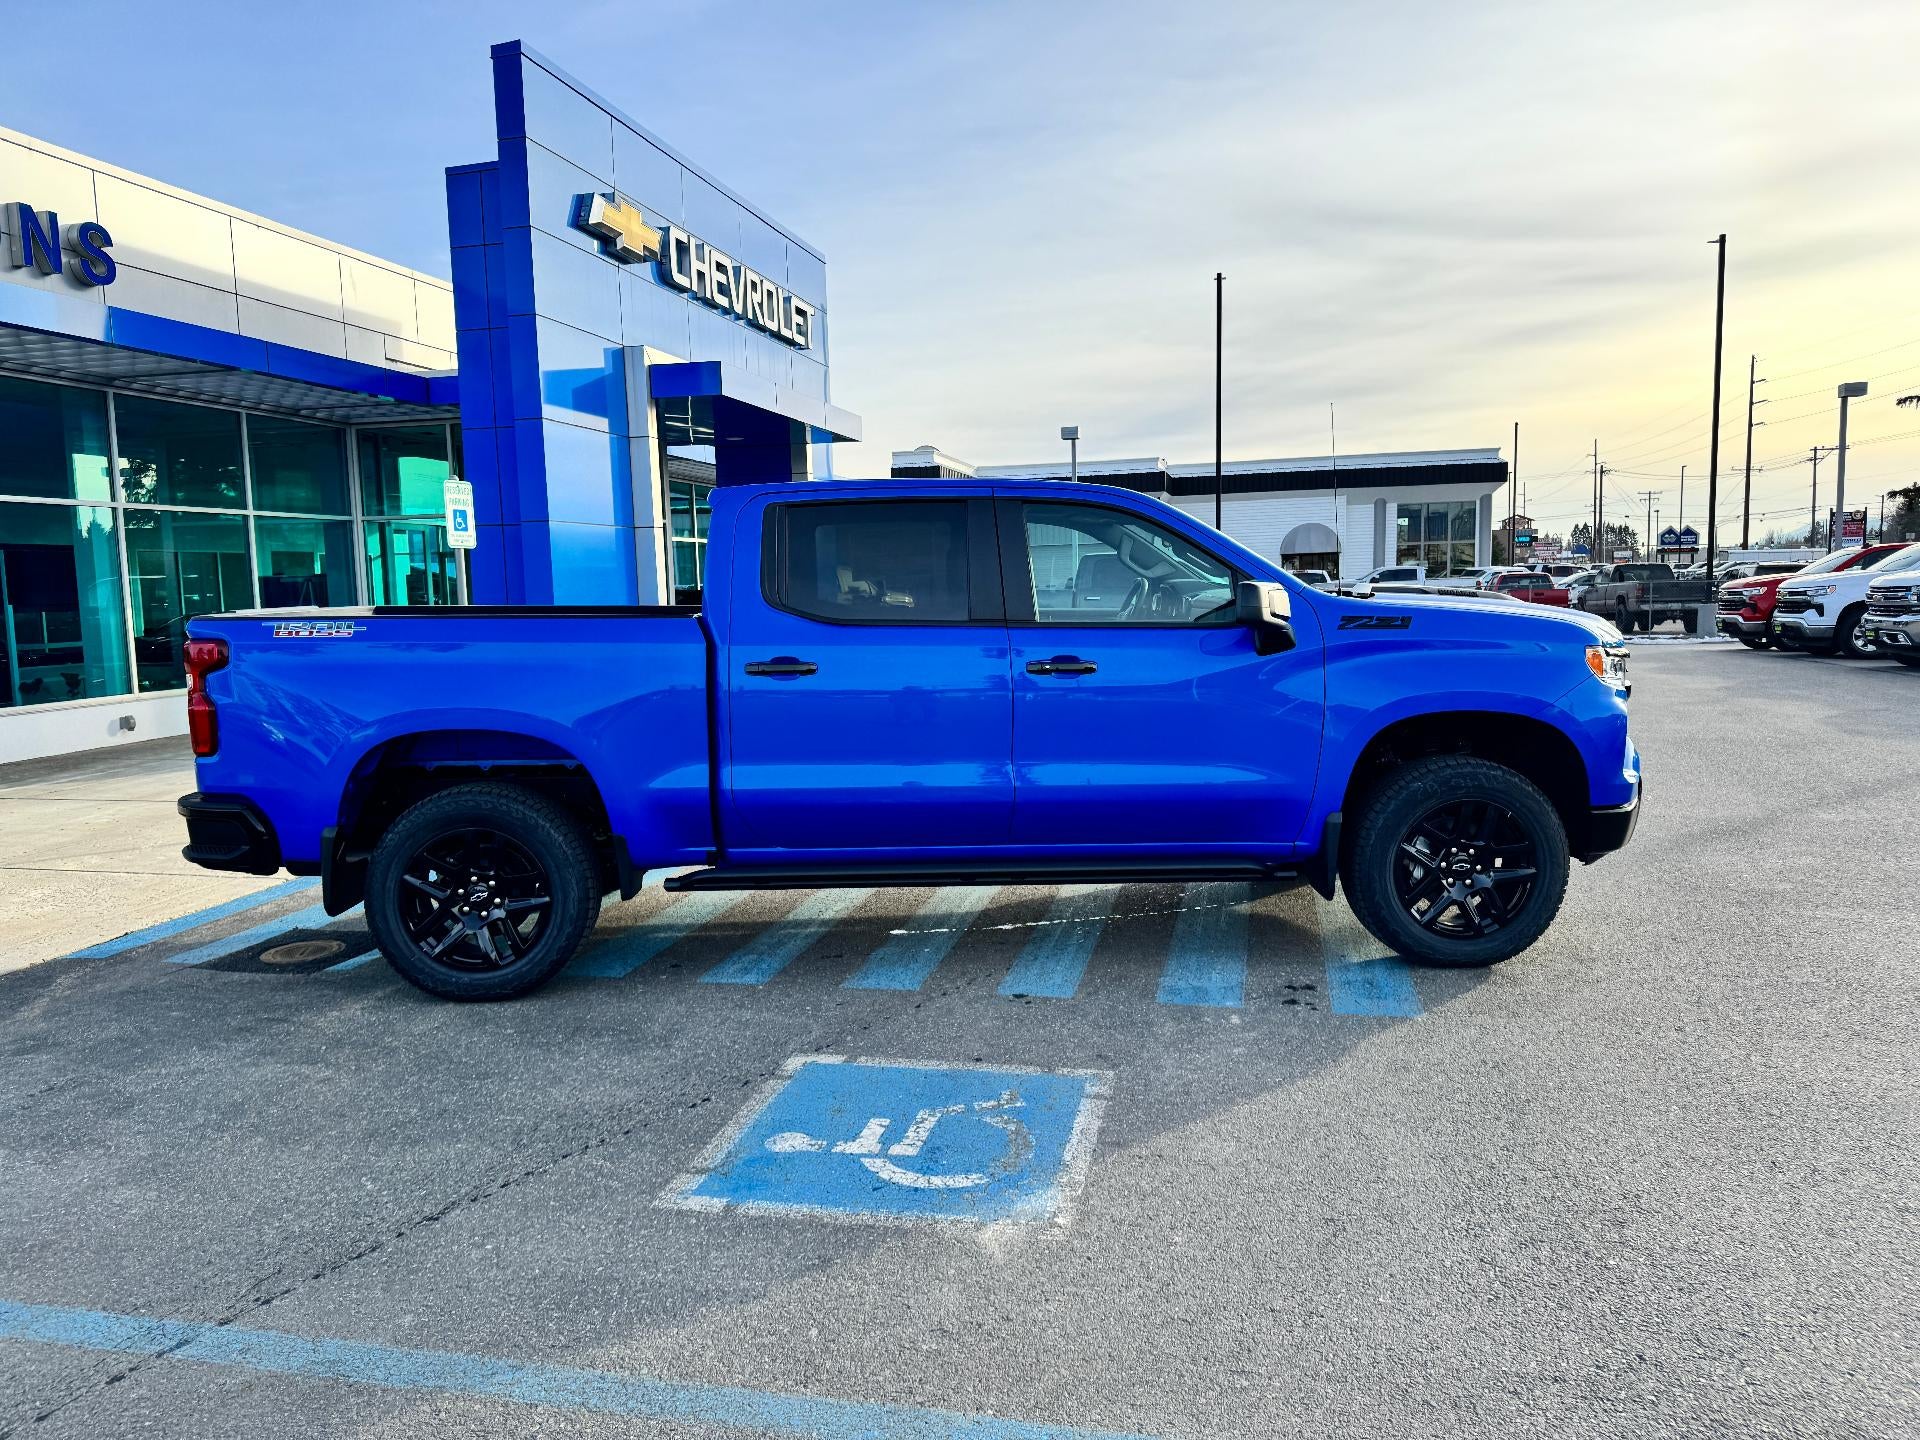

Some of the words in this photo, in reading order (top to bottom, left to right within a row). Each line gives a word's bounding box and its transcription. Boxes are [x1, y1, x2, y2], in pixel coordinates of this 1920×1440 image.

[0, 202, 117, 287] NS
[665, 226, 815, 350] CHEVROLET
[448, 497, 470, 508] PARKING
[262, 621, 367, 631] TRAIL
[1337, 615, 1413, 630] Z71
[273, 630, 353, 638] BOSS
